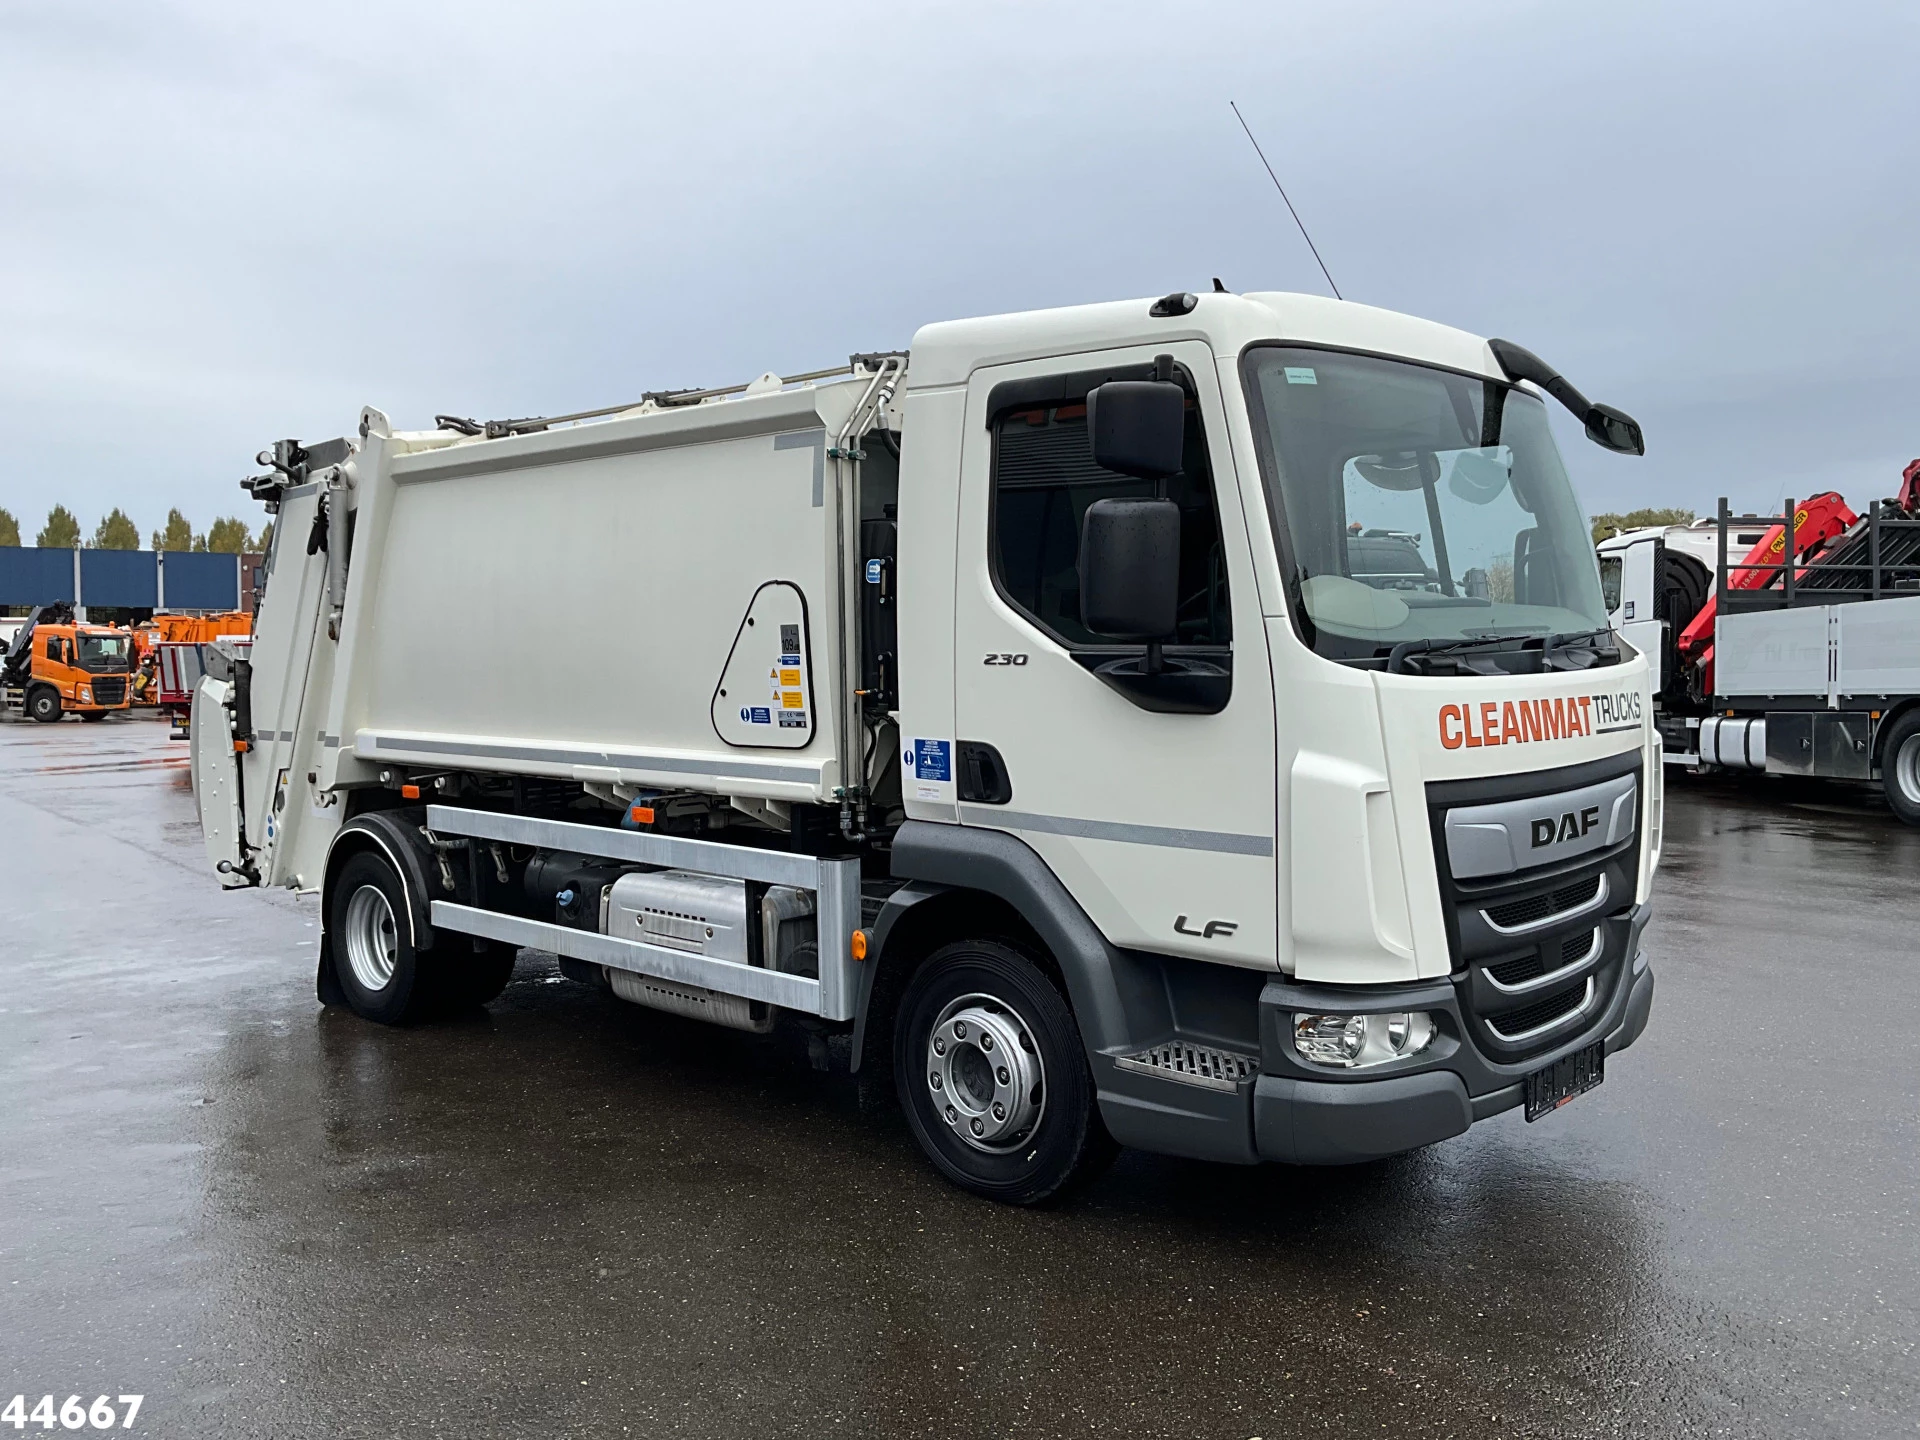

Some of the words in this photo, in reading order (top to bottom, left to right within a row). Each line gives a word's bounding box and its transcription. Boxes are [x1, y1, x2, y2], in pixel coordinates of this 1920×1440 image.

[782, 638, 794, 651] 109
[983, 653, 1029, 665] 230
[1439, 695, 1592, 750] CLEANMAT
[1592, 691, 1642, 724] TRUCKS
[1530, 805, 1599, 850] DAF
[1174, 915, 1239, 939] LF
